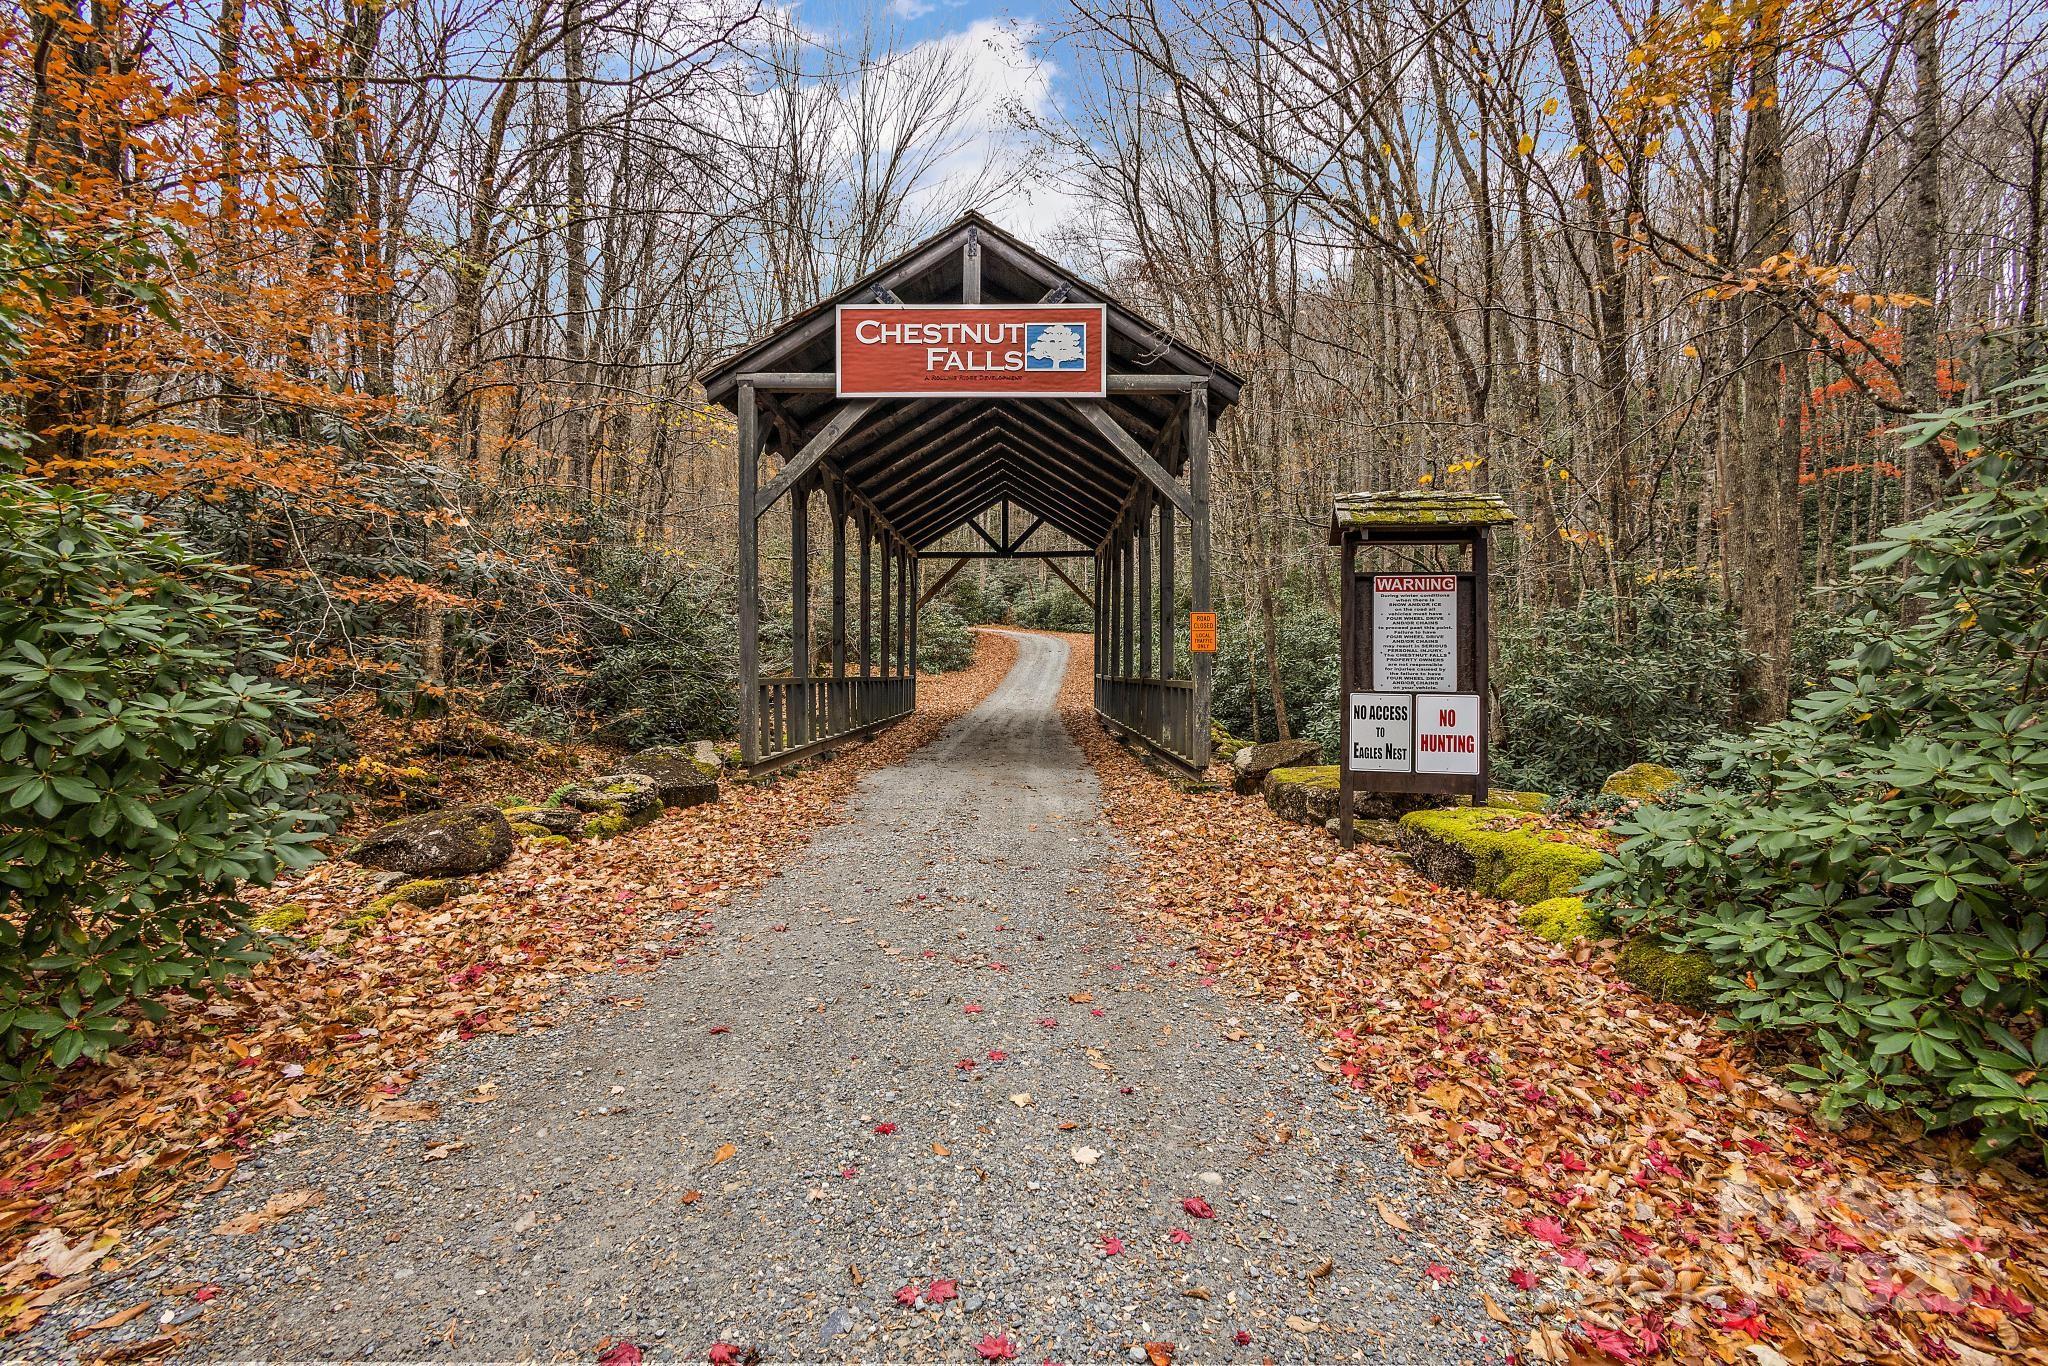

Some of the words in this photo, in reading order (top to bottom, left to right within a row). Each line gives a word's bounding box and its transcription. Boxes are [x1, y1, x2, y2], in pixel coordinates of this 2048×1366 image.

[855, 319, 1024, 345] CHESTNUT
[926, 347, 1023, 371] FALLS
[1377, 578, 1454, 591] WARNING
[1354, 704, 1366, 720] NO
[1369, 705, 1407, 721] ACCESS
[1440, 709, 1456, 727] NO
[1376, 727, 1385, 737] TO
[1354, 742, 1382, 759] EAGLES
[1385, 743, 1407, 760] NEST
[1421, 734, 1474, 753] HUNTING
